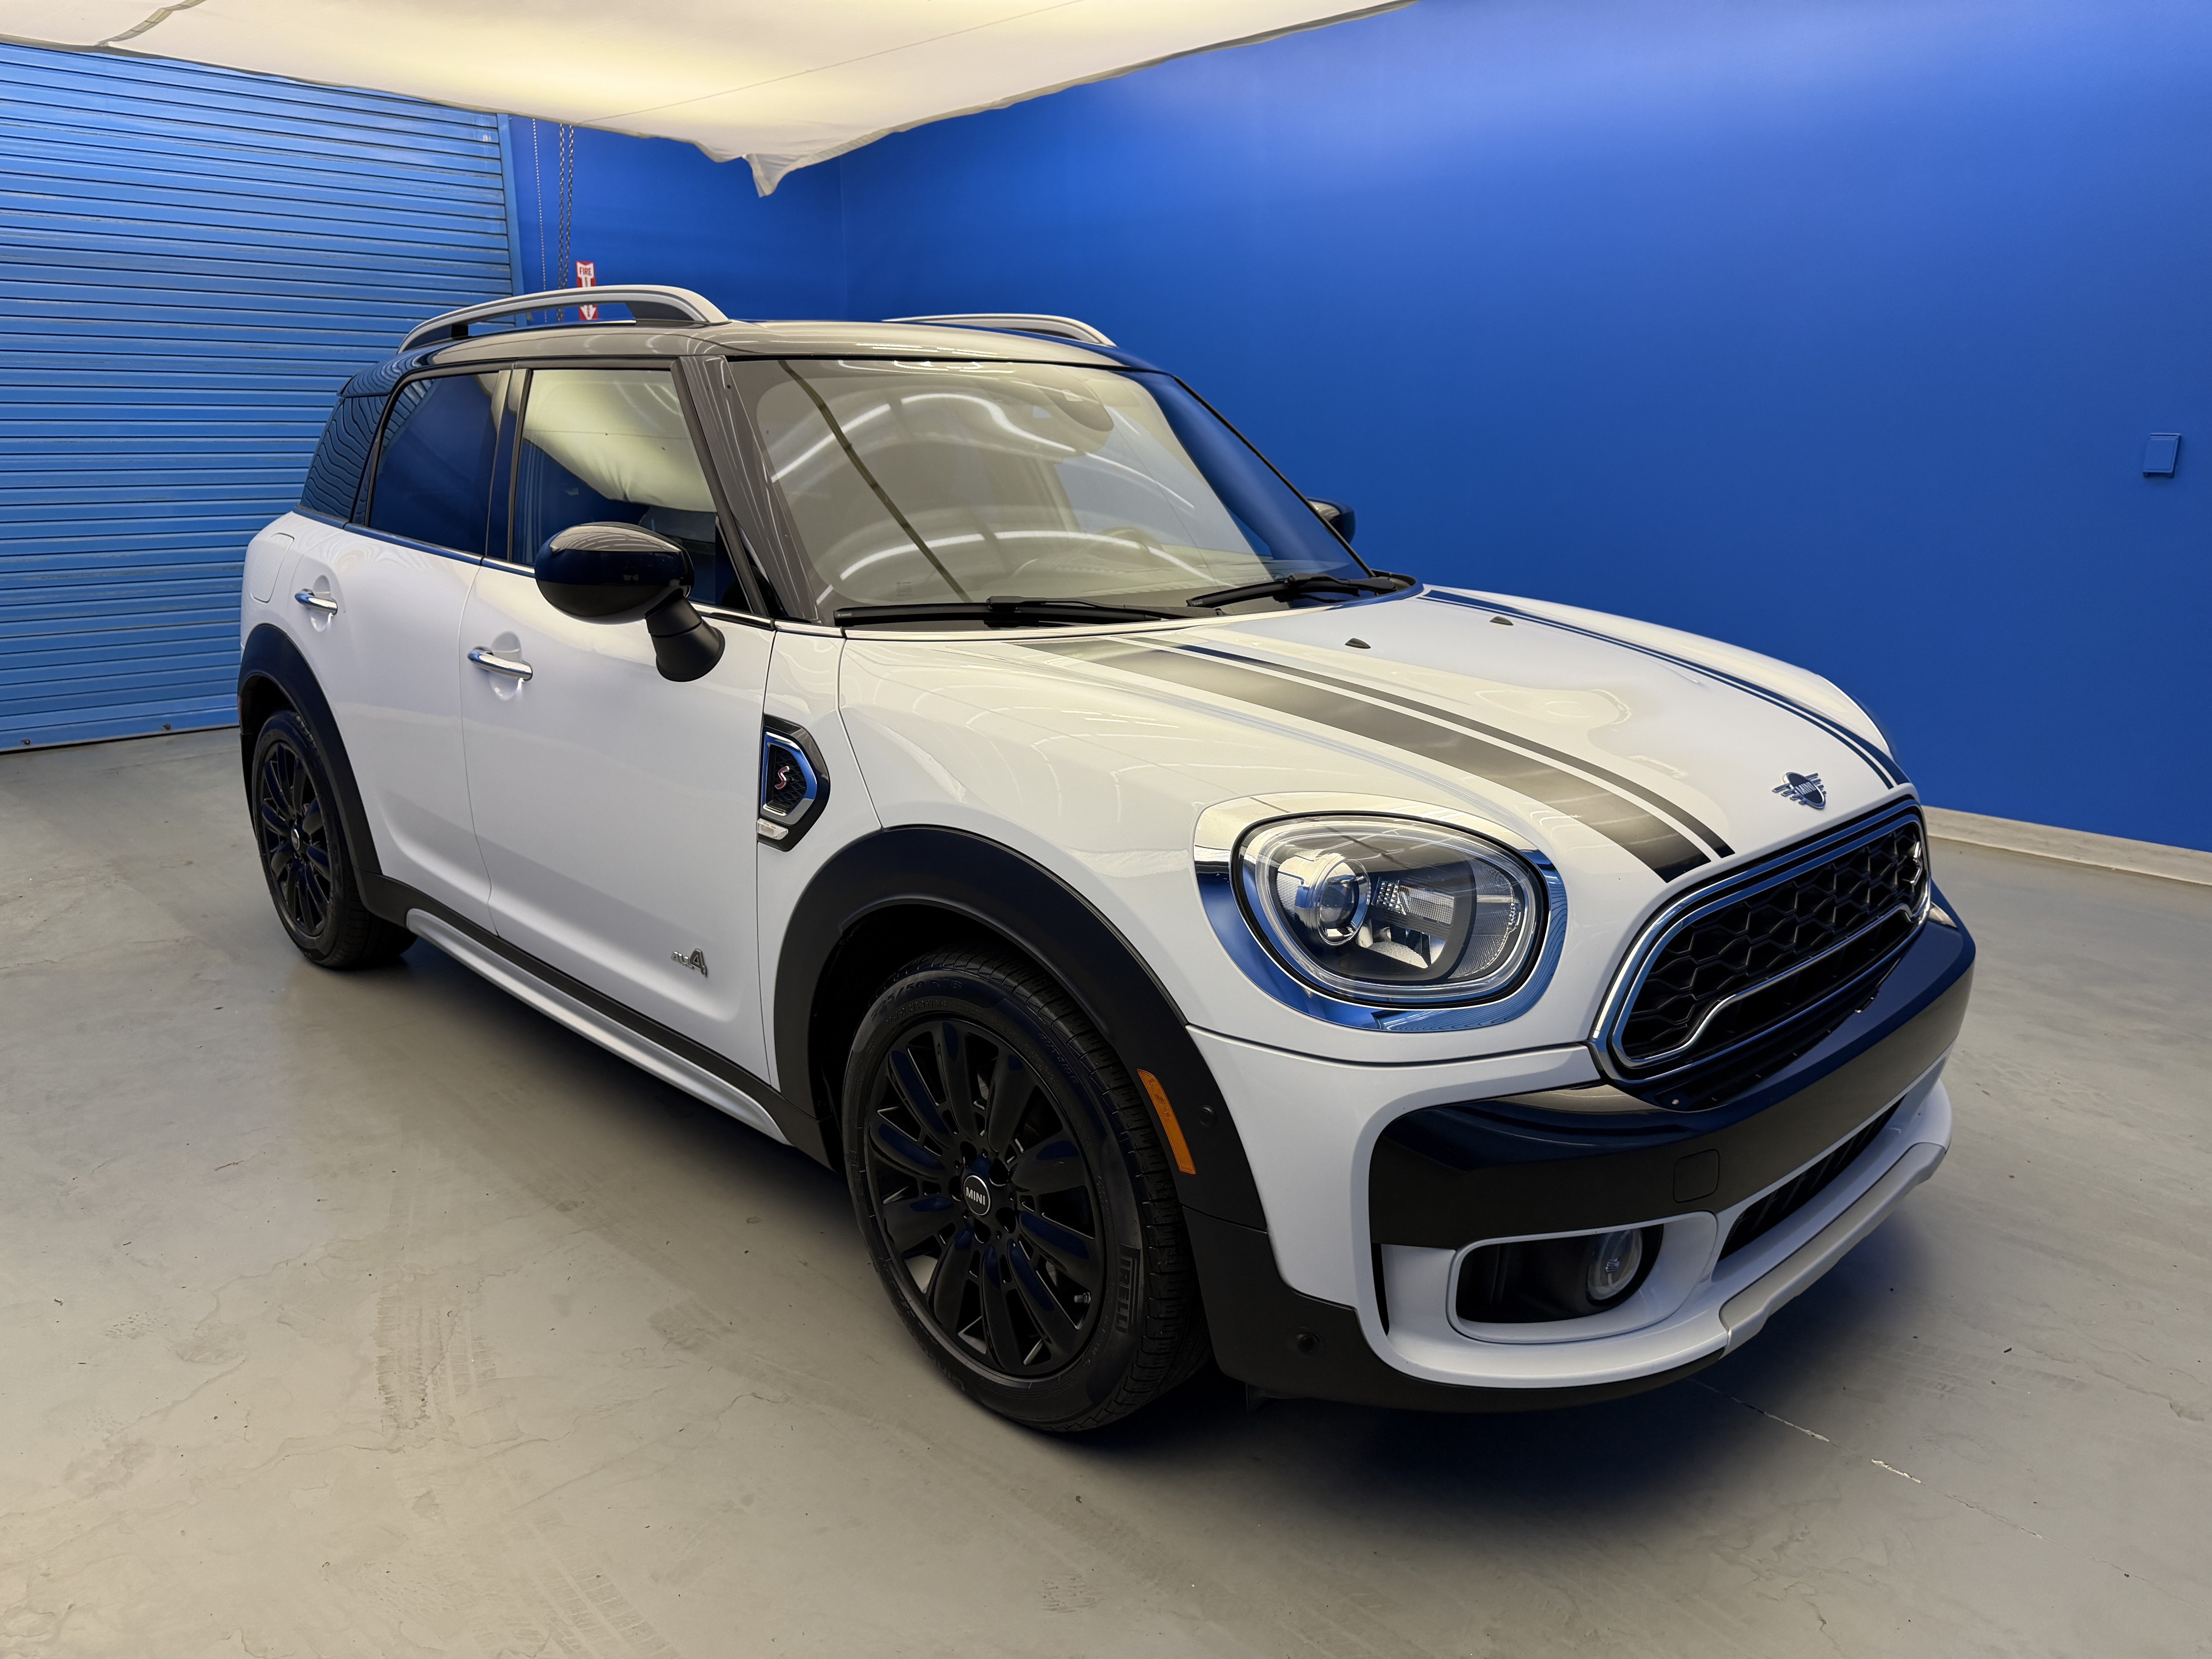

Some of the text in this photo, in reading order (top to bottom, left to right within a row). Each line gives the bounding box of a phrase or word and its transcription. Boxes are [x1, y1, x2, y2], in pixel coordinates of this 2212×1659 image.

[579, 266, 592, 276] FIRE
[774, 766, 790, 790] S
[1795, 781, 1817, 795] MINI
[966, 1187, 986, 1206] MINI
